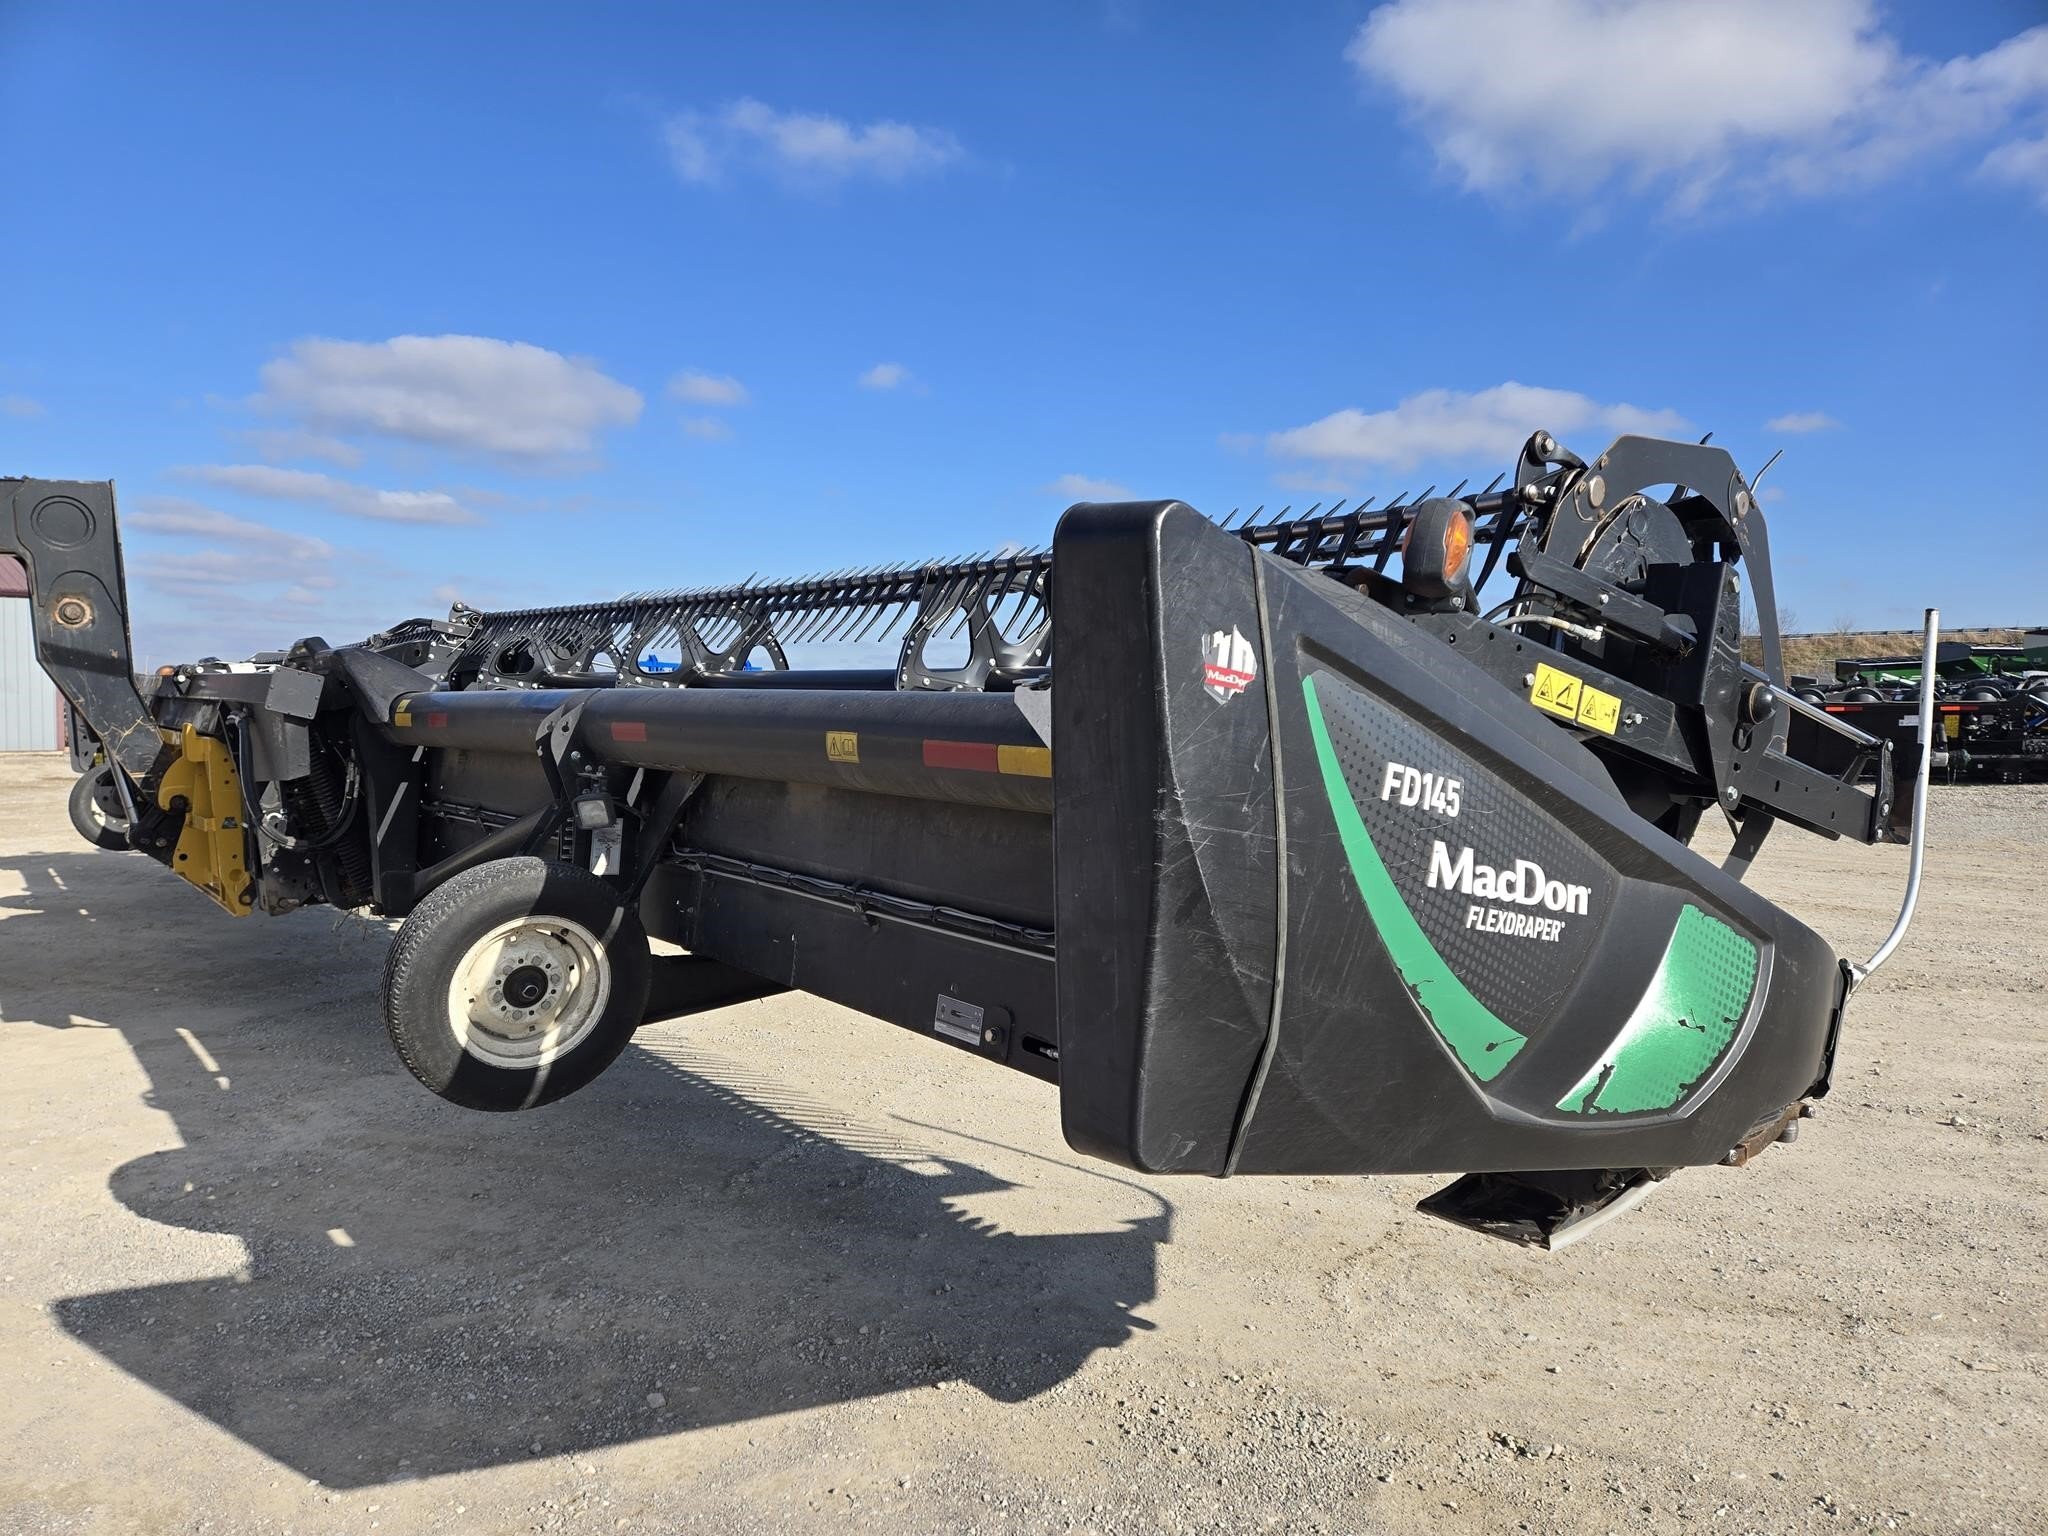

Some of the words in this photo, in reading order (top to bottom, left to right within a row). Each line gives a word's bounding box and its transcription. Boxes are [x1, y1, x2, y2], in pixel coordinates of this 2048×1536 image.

[1381, 761, 1463, 818] FD145
[1426, 840, 1590, 915] MacDon
[1465, 905, 1565, 942] FLEXDRAPER
